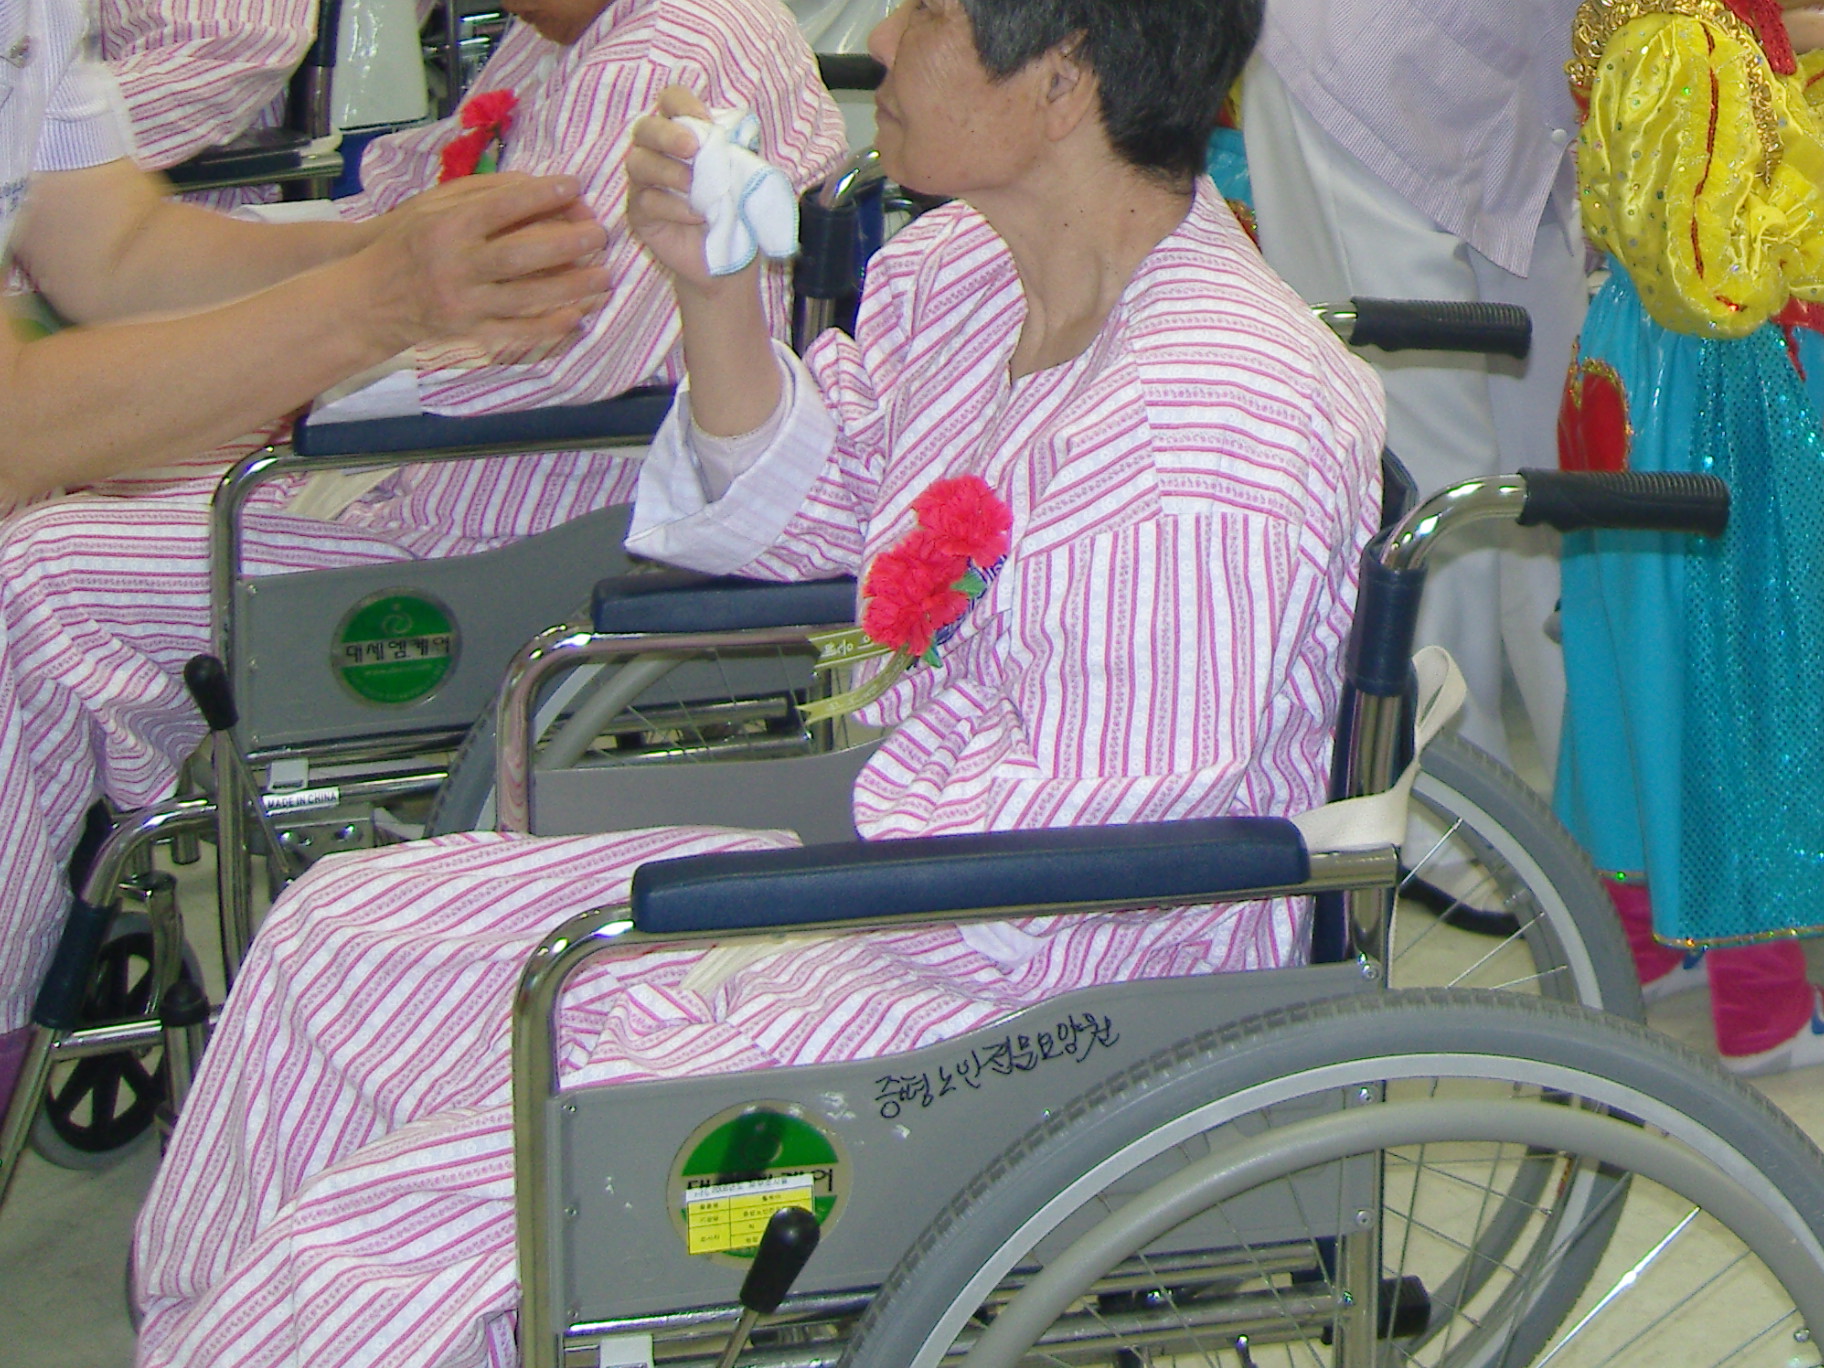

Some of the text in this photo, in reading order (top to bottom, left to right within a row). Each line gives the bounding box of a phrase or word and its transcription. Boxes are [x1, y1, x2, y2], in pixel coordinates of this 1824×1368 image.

[267, 791, 338, 809] MADE IN CHINA
